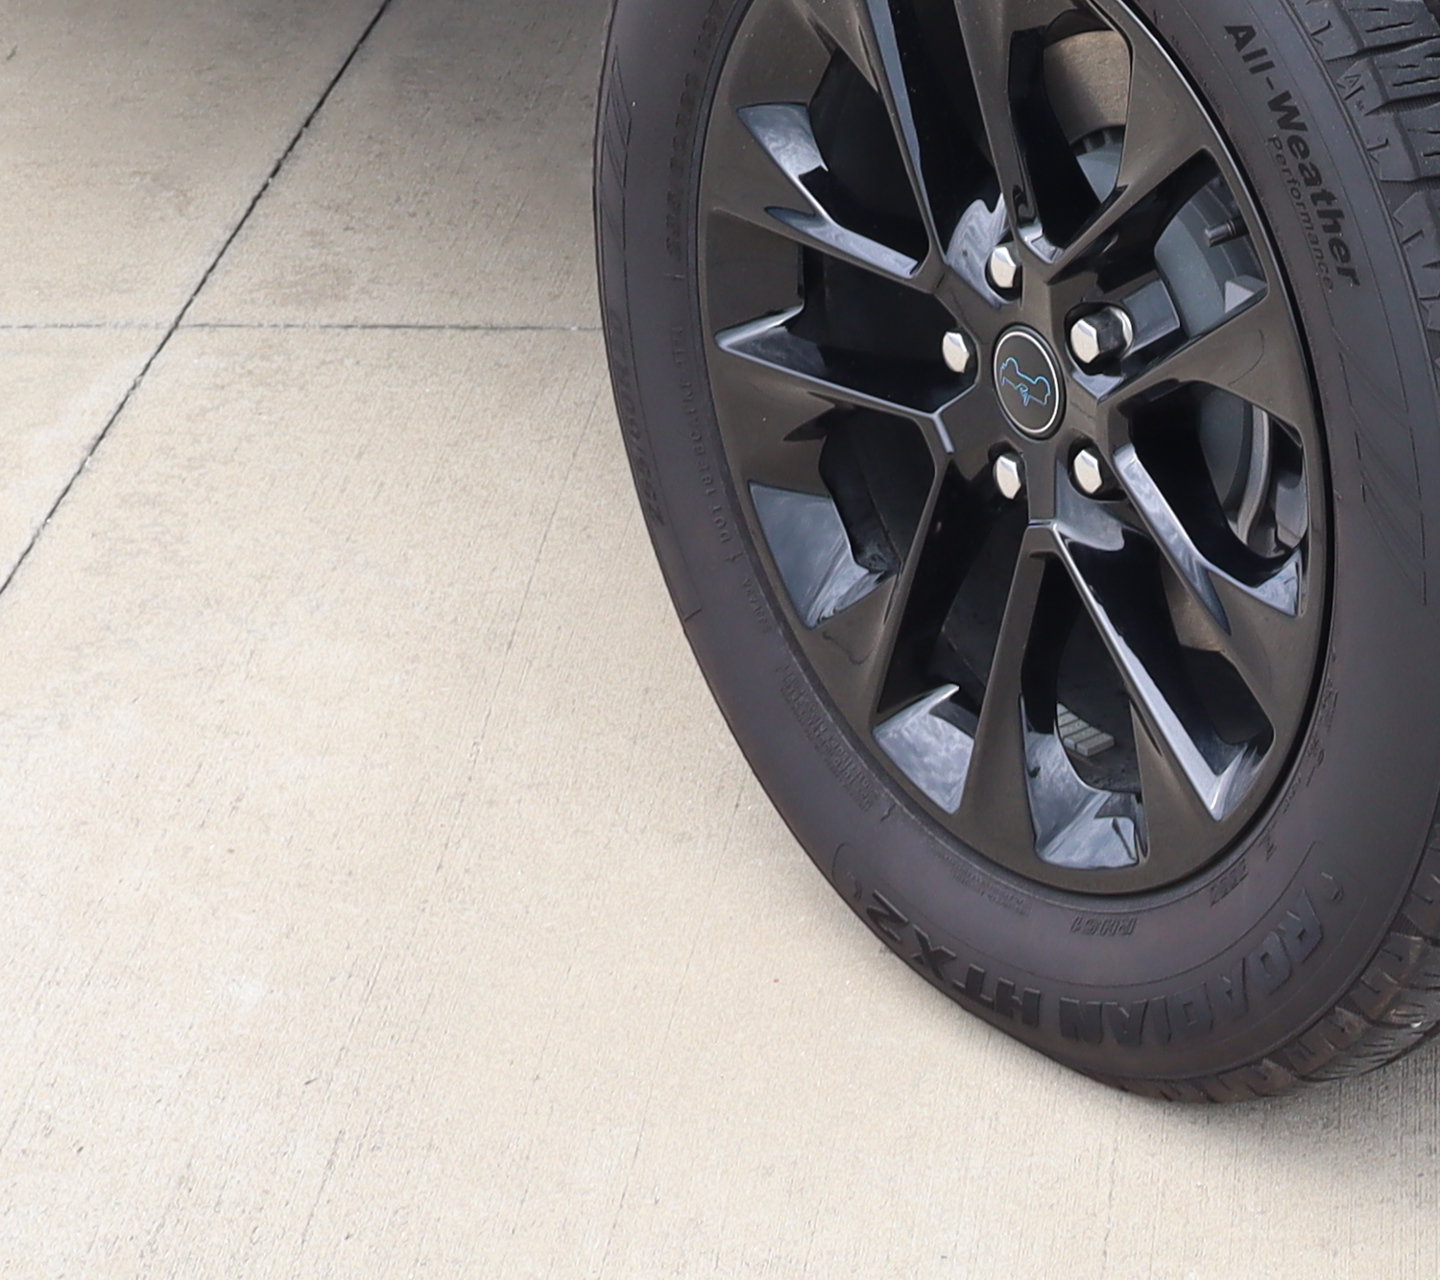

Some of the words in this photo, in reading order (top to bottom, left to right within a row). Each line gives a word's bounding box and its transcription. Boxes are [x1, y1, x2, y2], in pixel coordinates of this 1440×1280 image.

[1224, 24, 1361, 287] All-Weather
[1264, 136, 1335, 290] Performance
[1059, 888, 1324, 1046] ROADIAN
